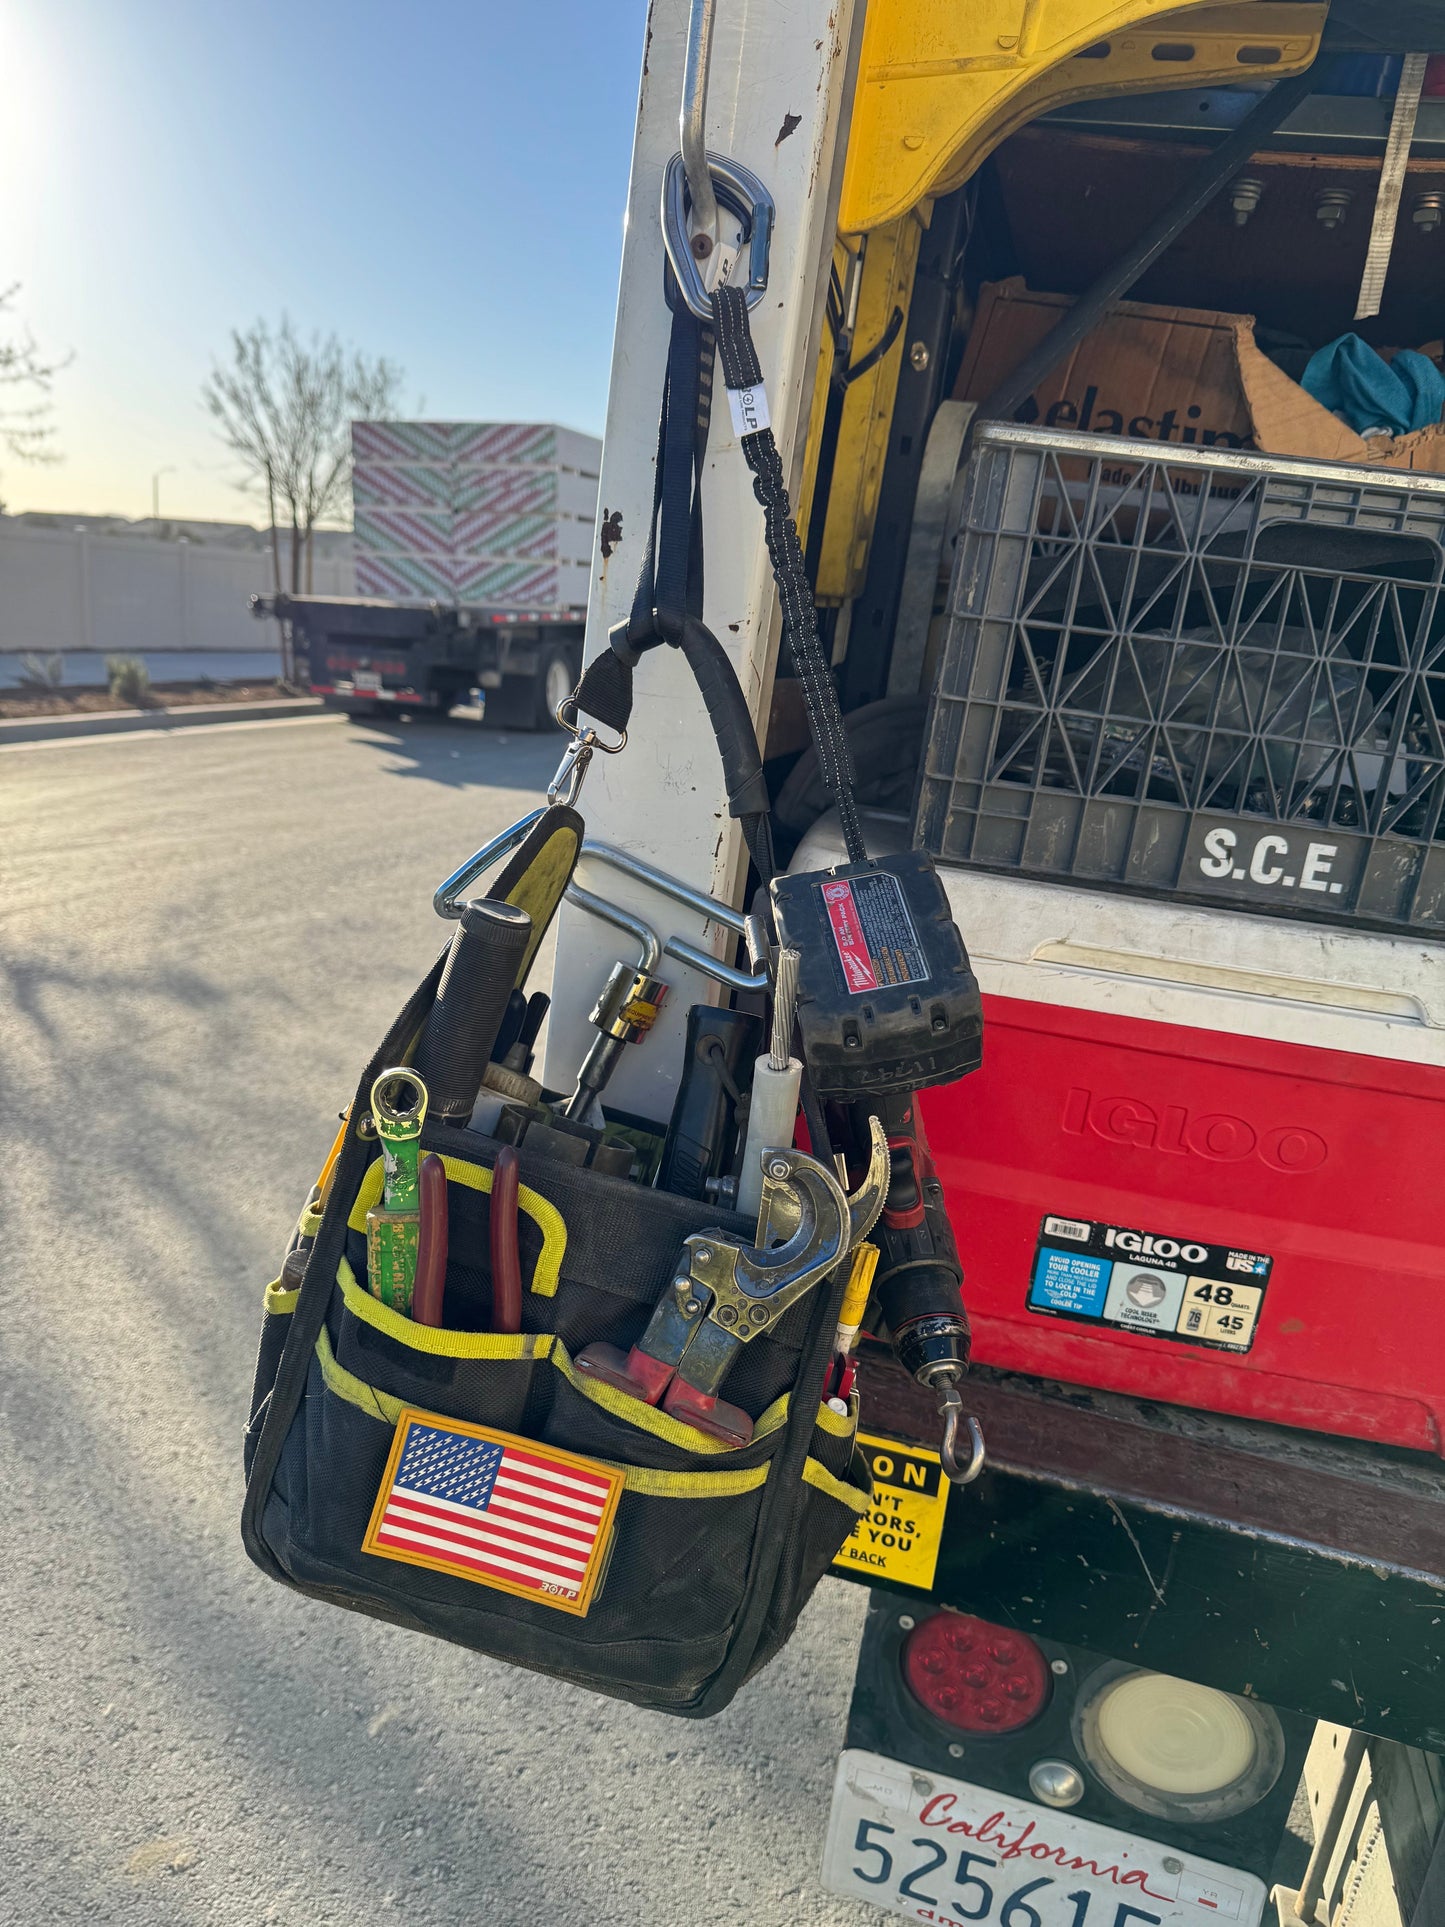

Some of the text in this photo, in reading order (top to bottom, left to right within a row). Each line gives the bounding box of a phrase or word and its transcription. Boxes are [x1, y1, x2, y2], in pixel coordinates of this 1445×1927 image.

[1200, 828, 1343, 894] S.C.E.
[842, 951, 870, 988] Milwaukee
[1062, 1086, 1329, 1174] IGLOO
[1104, 1228, 1209, 1263] IGLOO
[1050, 1256, 1101, 1271] AVOID OPENING
[1129, 1254, 1178, 1269] LAGUNA 48
[1228, 1251, 1271, 1264] MADE IN THE
[1049, 1262, 1099, 1278] YOUR COOLER
[1058, 1277, 1075, 1285] CLOSE
[1055, 1282, 1072, 1291] LOCK
[1073, 1285, 1081, 1293] IN
[1082, 1287, 1096, 1296] THE
[1060, 1290, 1077, 1299] COLD
[1194, 1283, 1234, 1306] 48
[1125, 1307, 1139, 1316] COOL
[1189, 1311, 1201, 1323] 76
[1217, 1315, 1244, 1330] 45
[868, 1528, 912, 1552] YOU
[850, 1547, 887, 1568] BACK
[919, 1793, 1175, 1903] California
[1202, 1888, 1218, 1899] YR
